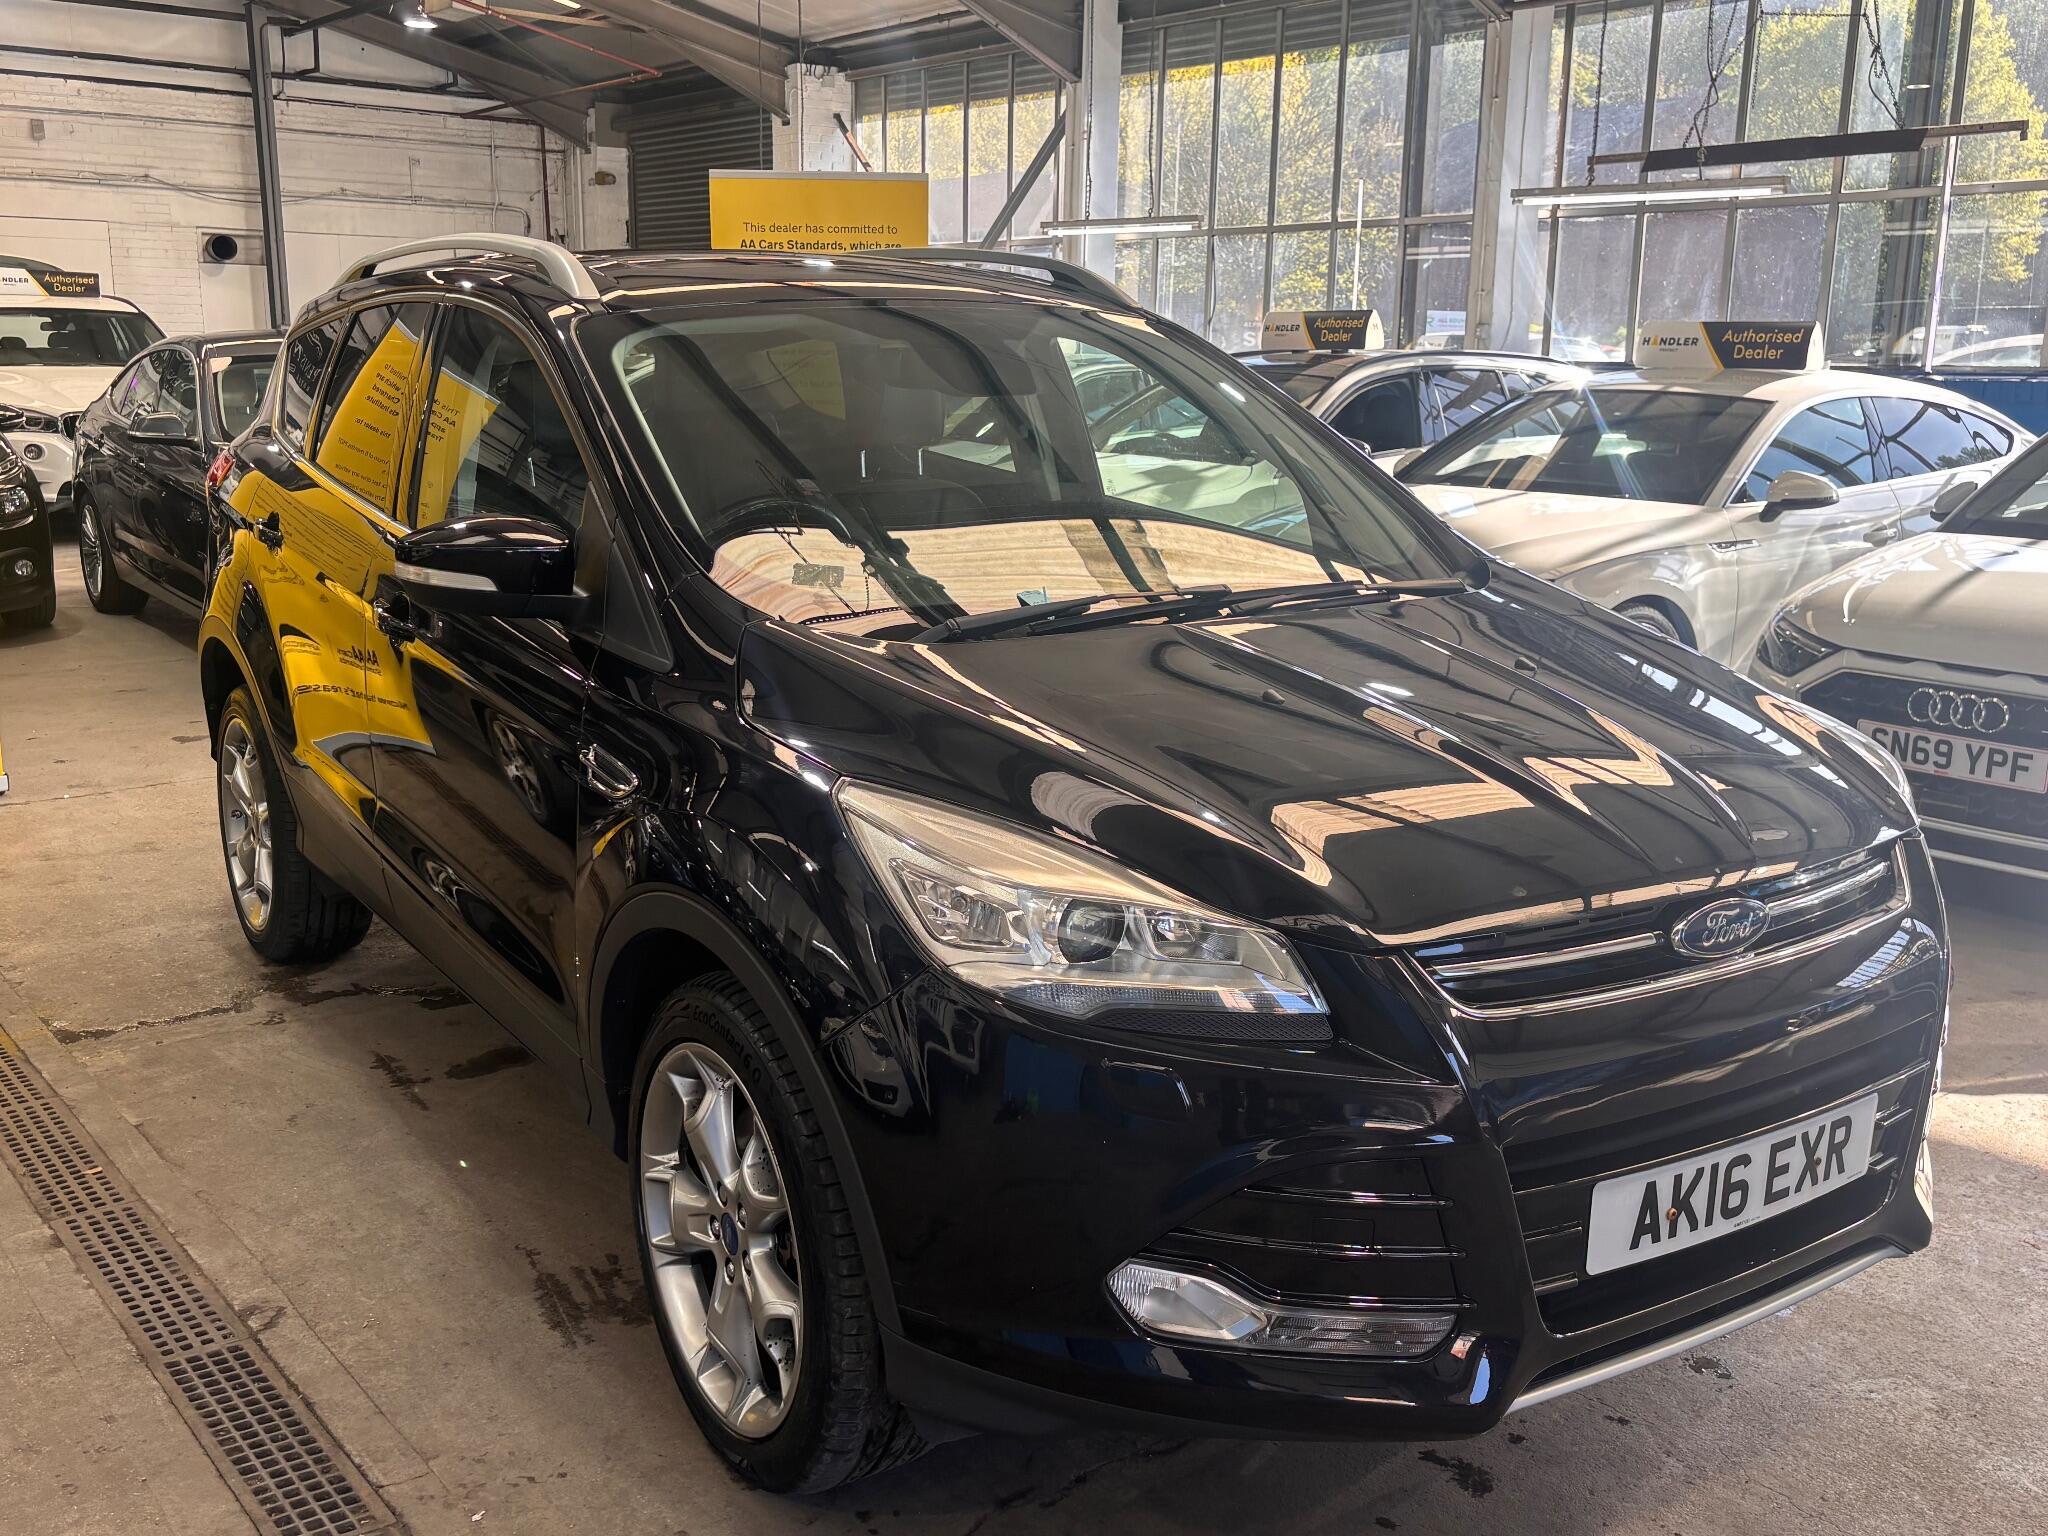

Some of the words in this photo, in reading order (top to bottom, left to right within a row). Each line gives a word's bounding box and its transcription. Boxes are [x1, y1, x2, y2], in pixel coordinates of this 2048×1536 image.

[743, 222, 766, 233] This
[769, 222, 802, 233] dealer
[805, 223, 824, 234] has
[827, 223, 884, 235] committed
[888, 225, 898, 235] to
[740, 240, 756, 249] AA
[759, 240, 784, 250] Cars
[787, 240, 847, 251] Standards,
[850, 241, 882, 251] which
[43, 273, 95, 285] Authorised
[53, 283, 86, 293] Dealer
[1264, 324, 1301, 333] HANDLER
[1314, 316, 1365, 329] Authorised
[1321, 329, 1352, 342] Dealer
[1642, 336, 1699, 346] HANDLER
[1721, 328, 1805, 343] Authorised
[1733, 344, 1784, 360] Dealer
[1871, 727, 1954, 770] SN69
[1966, 743, 2034, 783] YPF
[1702, 907, 1760, 947] Ford
[1629, 1153, 1752, 1251] AK16
[1763, 1115, 1853, 1206] EXR
